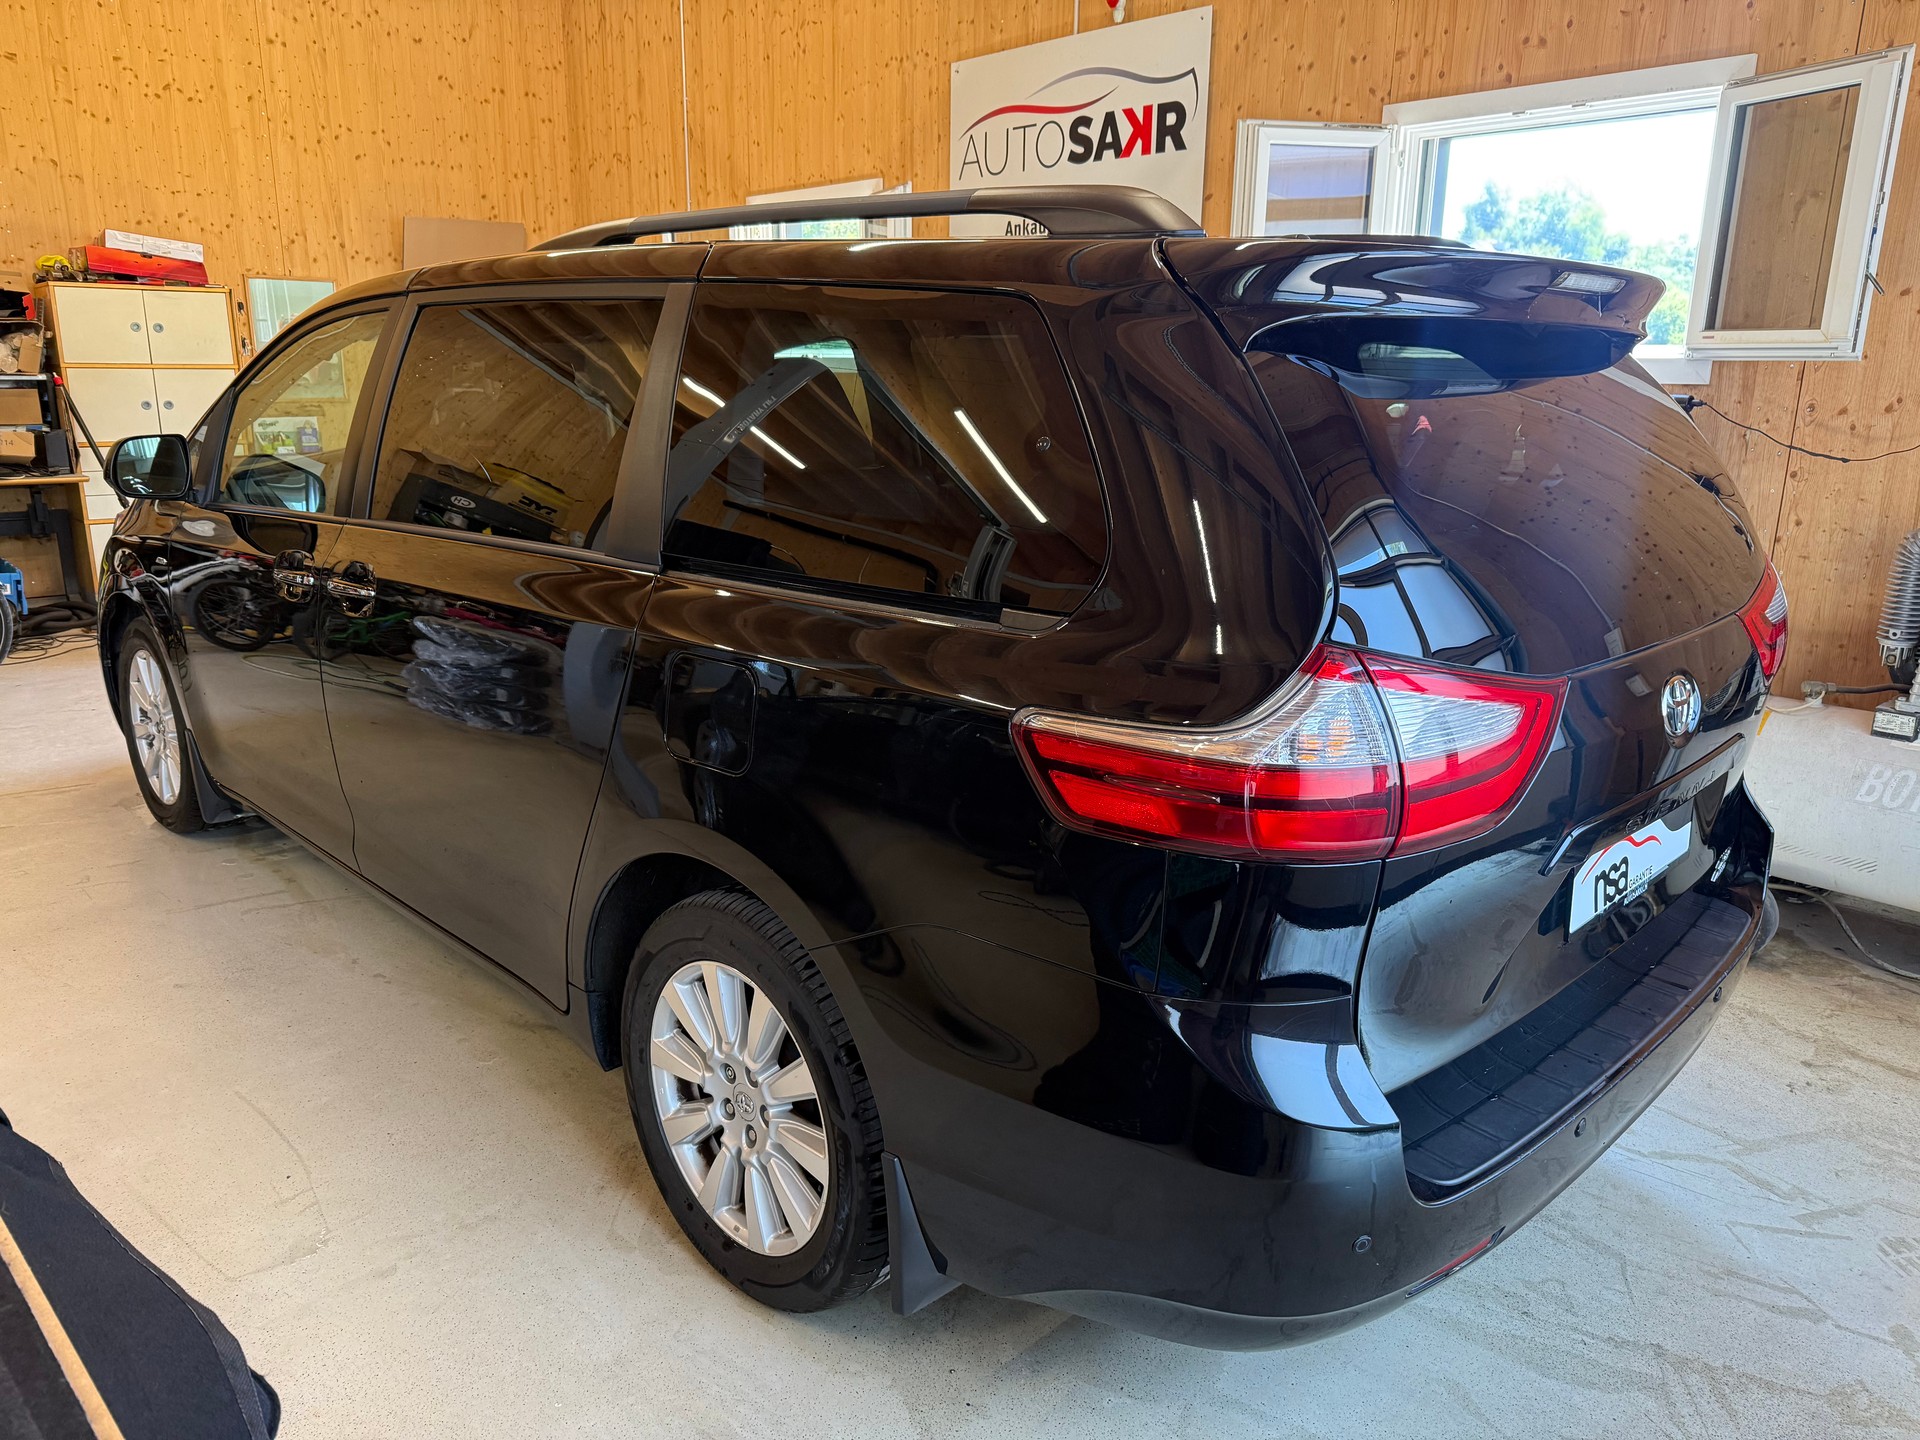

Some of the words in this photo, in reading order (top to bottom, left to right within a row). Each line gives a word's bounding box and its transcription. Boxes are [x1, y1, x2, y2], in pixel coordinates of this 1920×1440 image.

[958, 101, 1188, 181] AUTOSAKR
[1855, 763, 1920, 812] BO
[1594, 856, 1629, 914] nsa
[1629, 864, 1653, 889] GARANTIE
